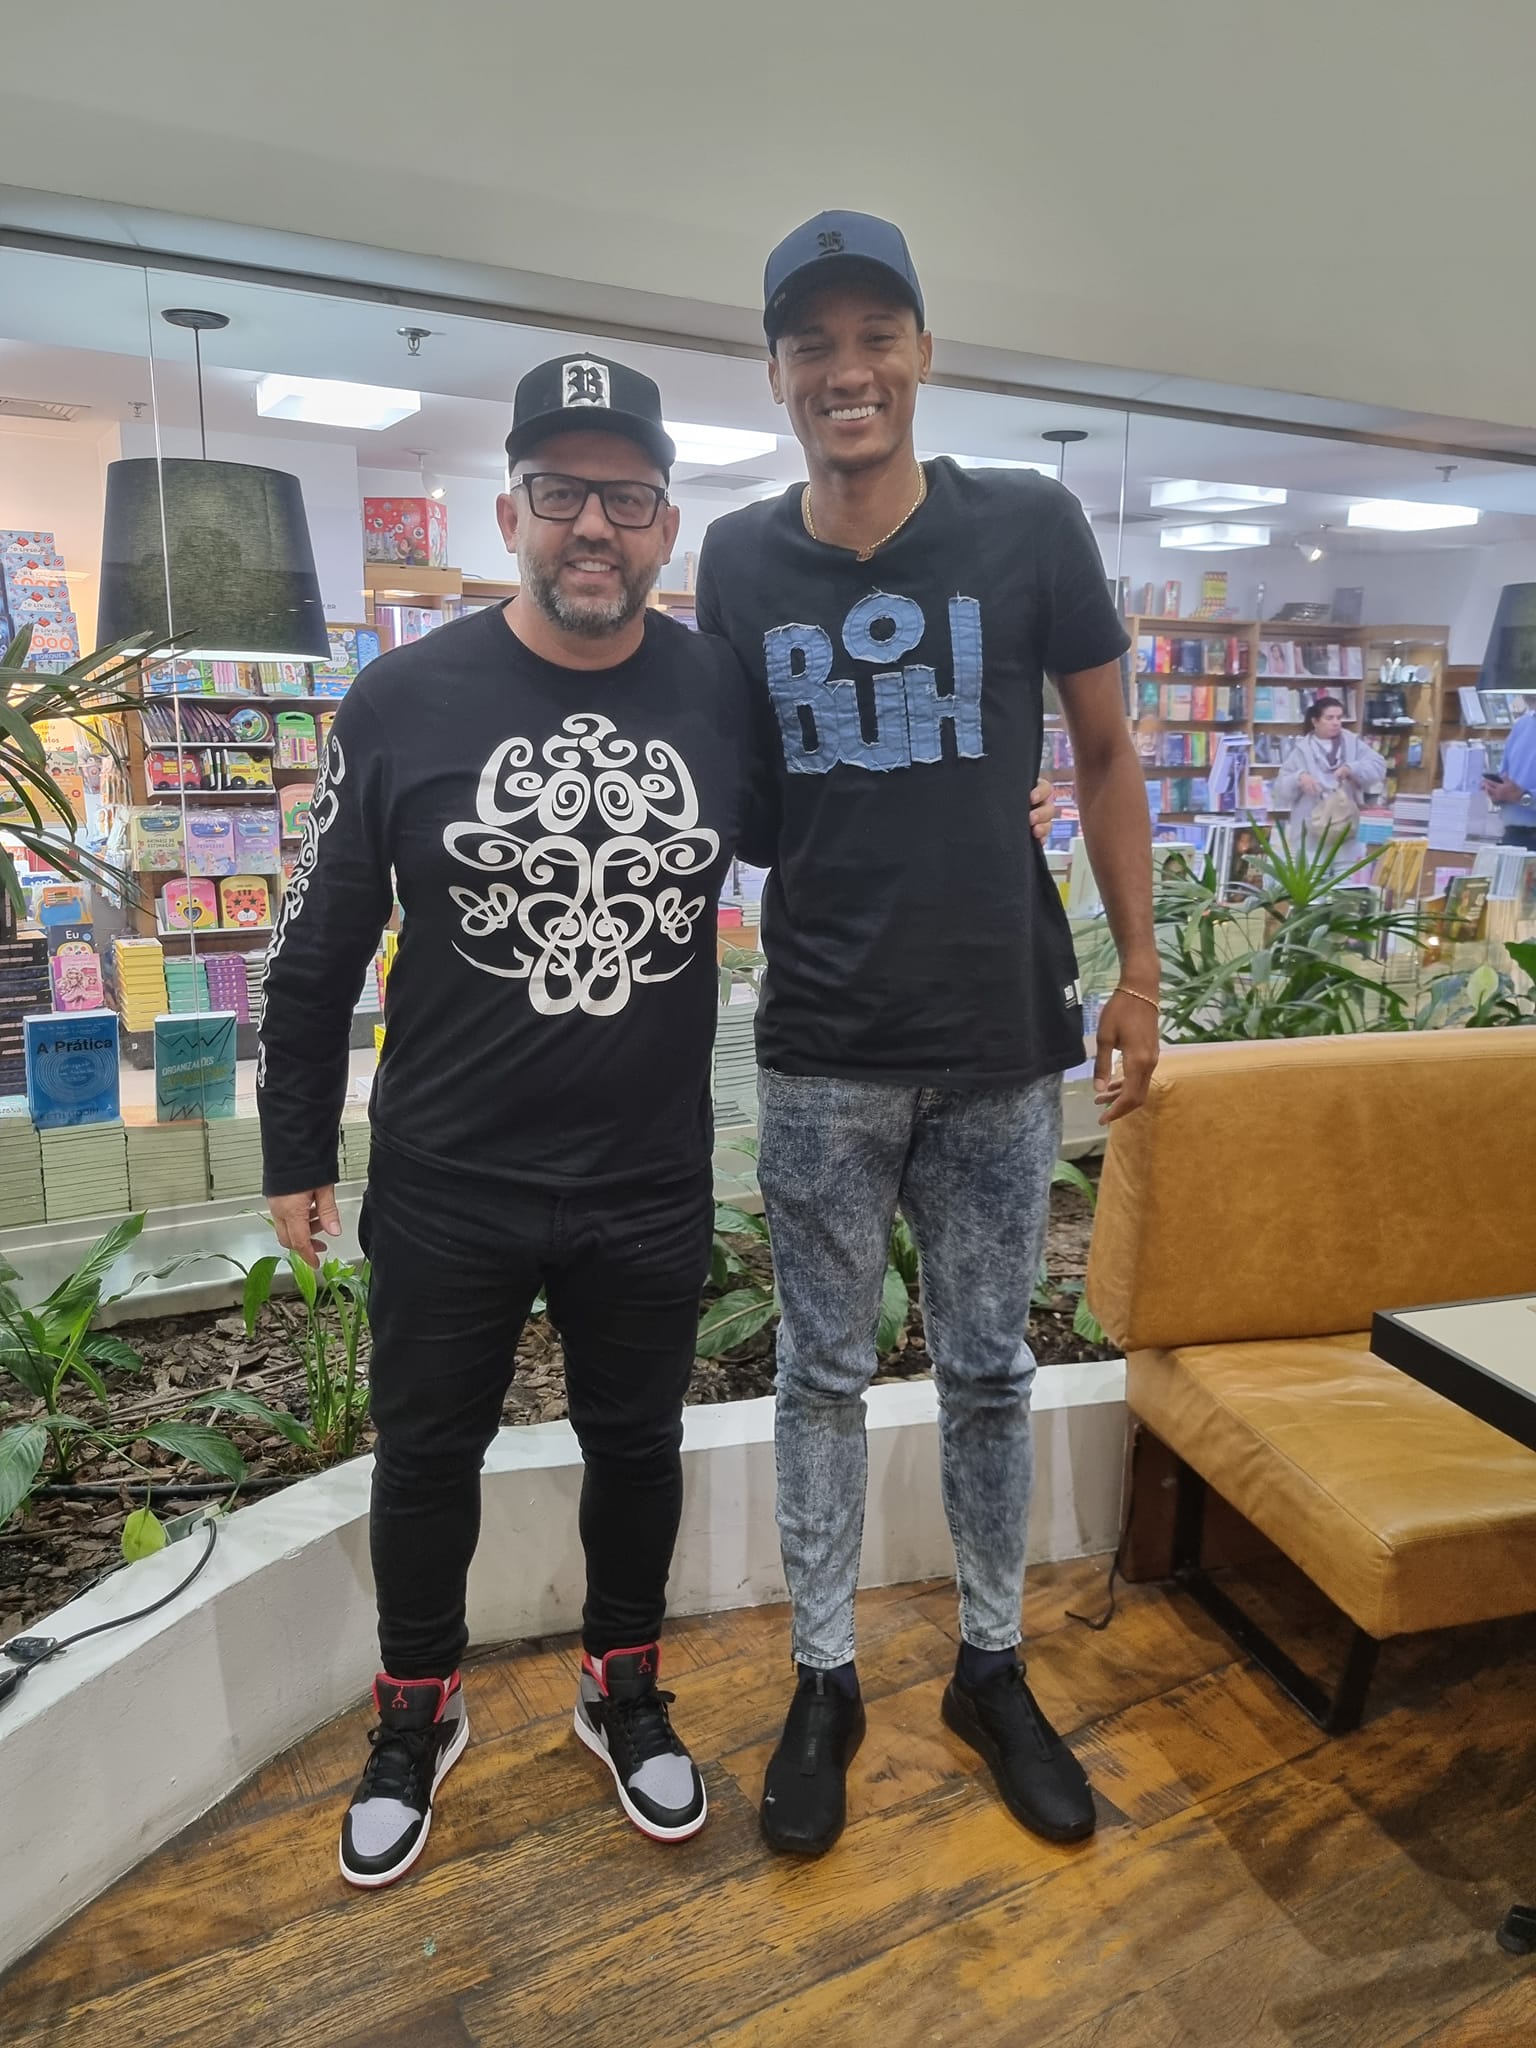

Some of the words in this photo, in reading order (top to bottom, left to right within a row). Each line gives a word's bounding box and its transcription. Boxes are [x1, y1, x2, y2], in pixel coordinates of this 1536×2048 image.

[567, 365, 605, 403] B
[65, 930, 80, 940] Eu
[37, 1042, 49, 1055] A
[55, 1038, 113, 1053] Prática
